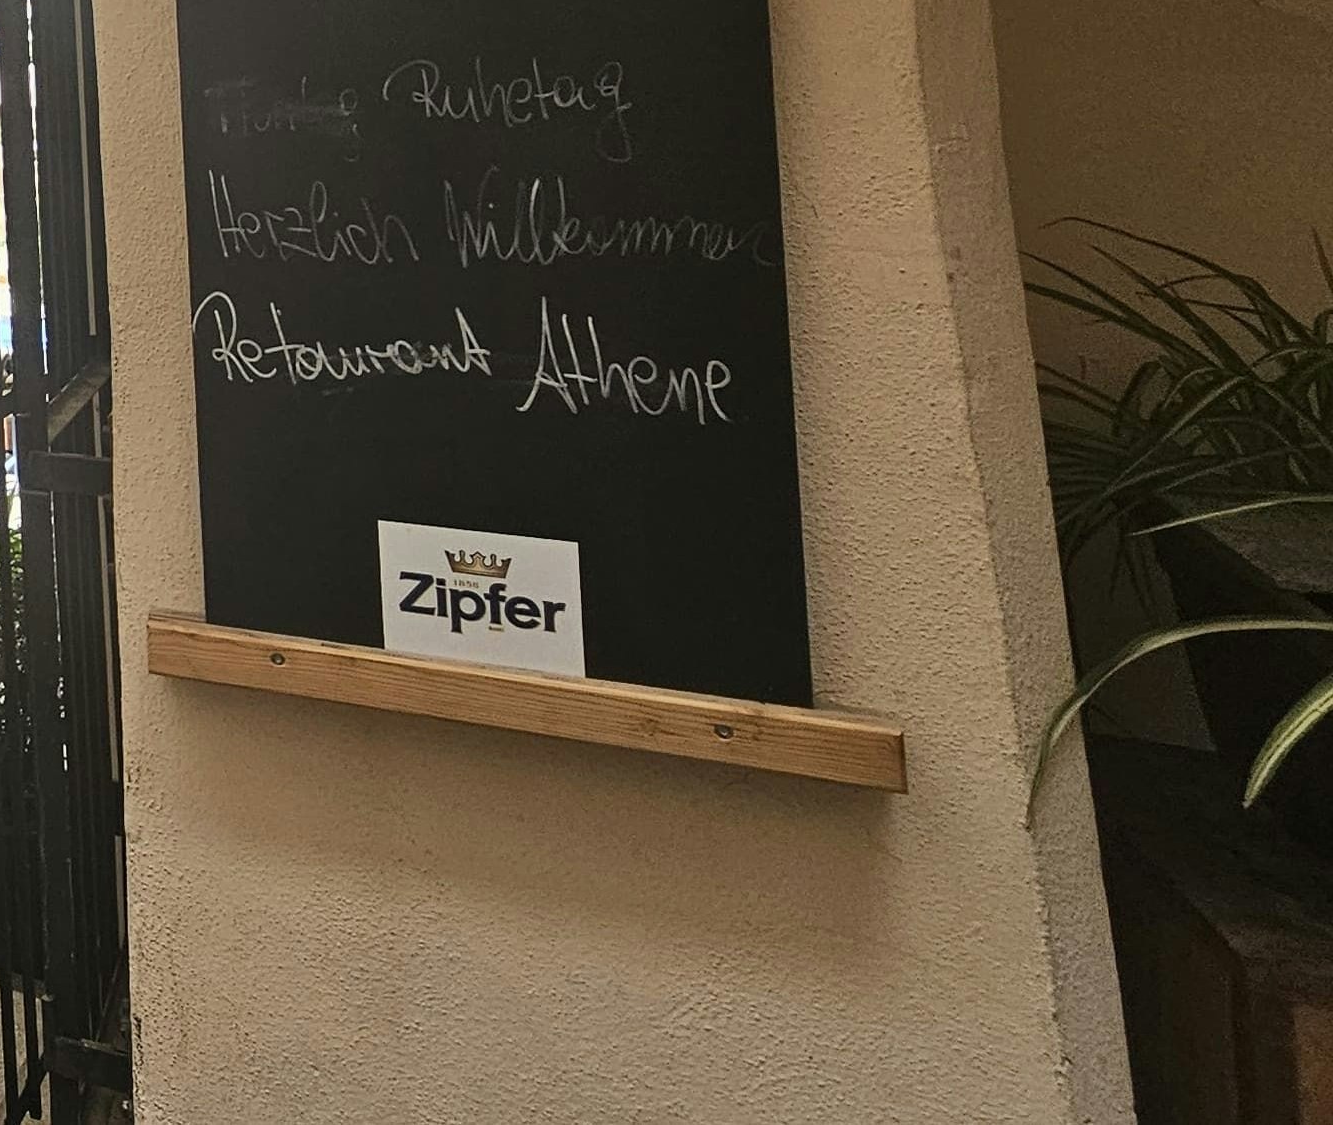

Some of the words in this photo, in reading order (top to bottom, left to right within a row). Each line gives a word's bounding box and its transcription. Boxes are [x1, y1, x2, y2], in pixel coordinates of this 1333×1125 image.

[383, 56, 632, 163] Ruhetag
[209, 170, 419, 264] Herzlich
[516, 295, 731, 424] Athene
[399, 570, 566, 634] Zipfer
